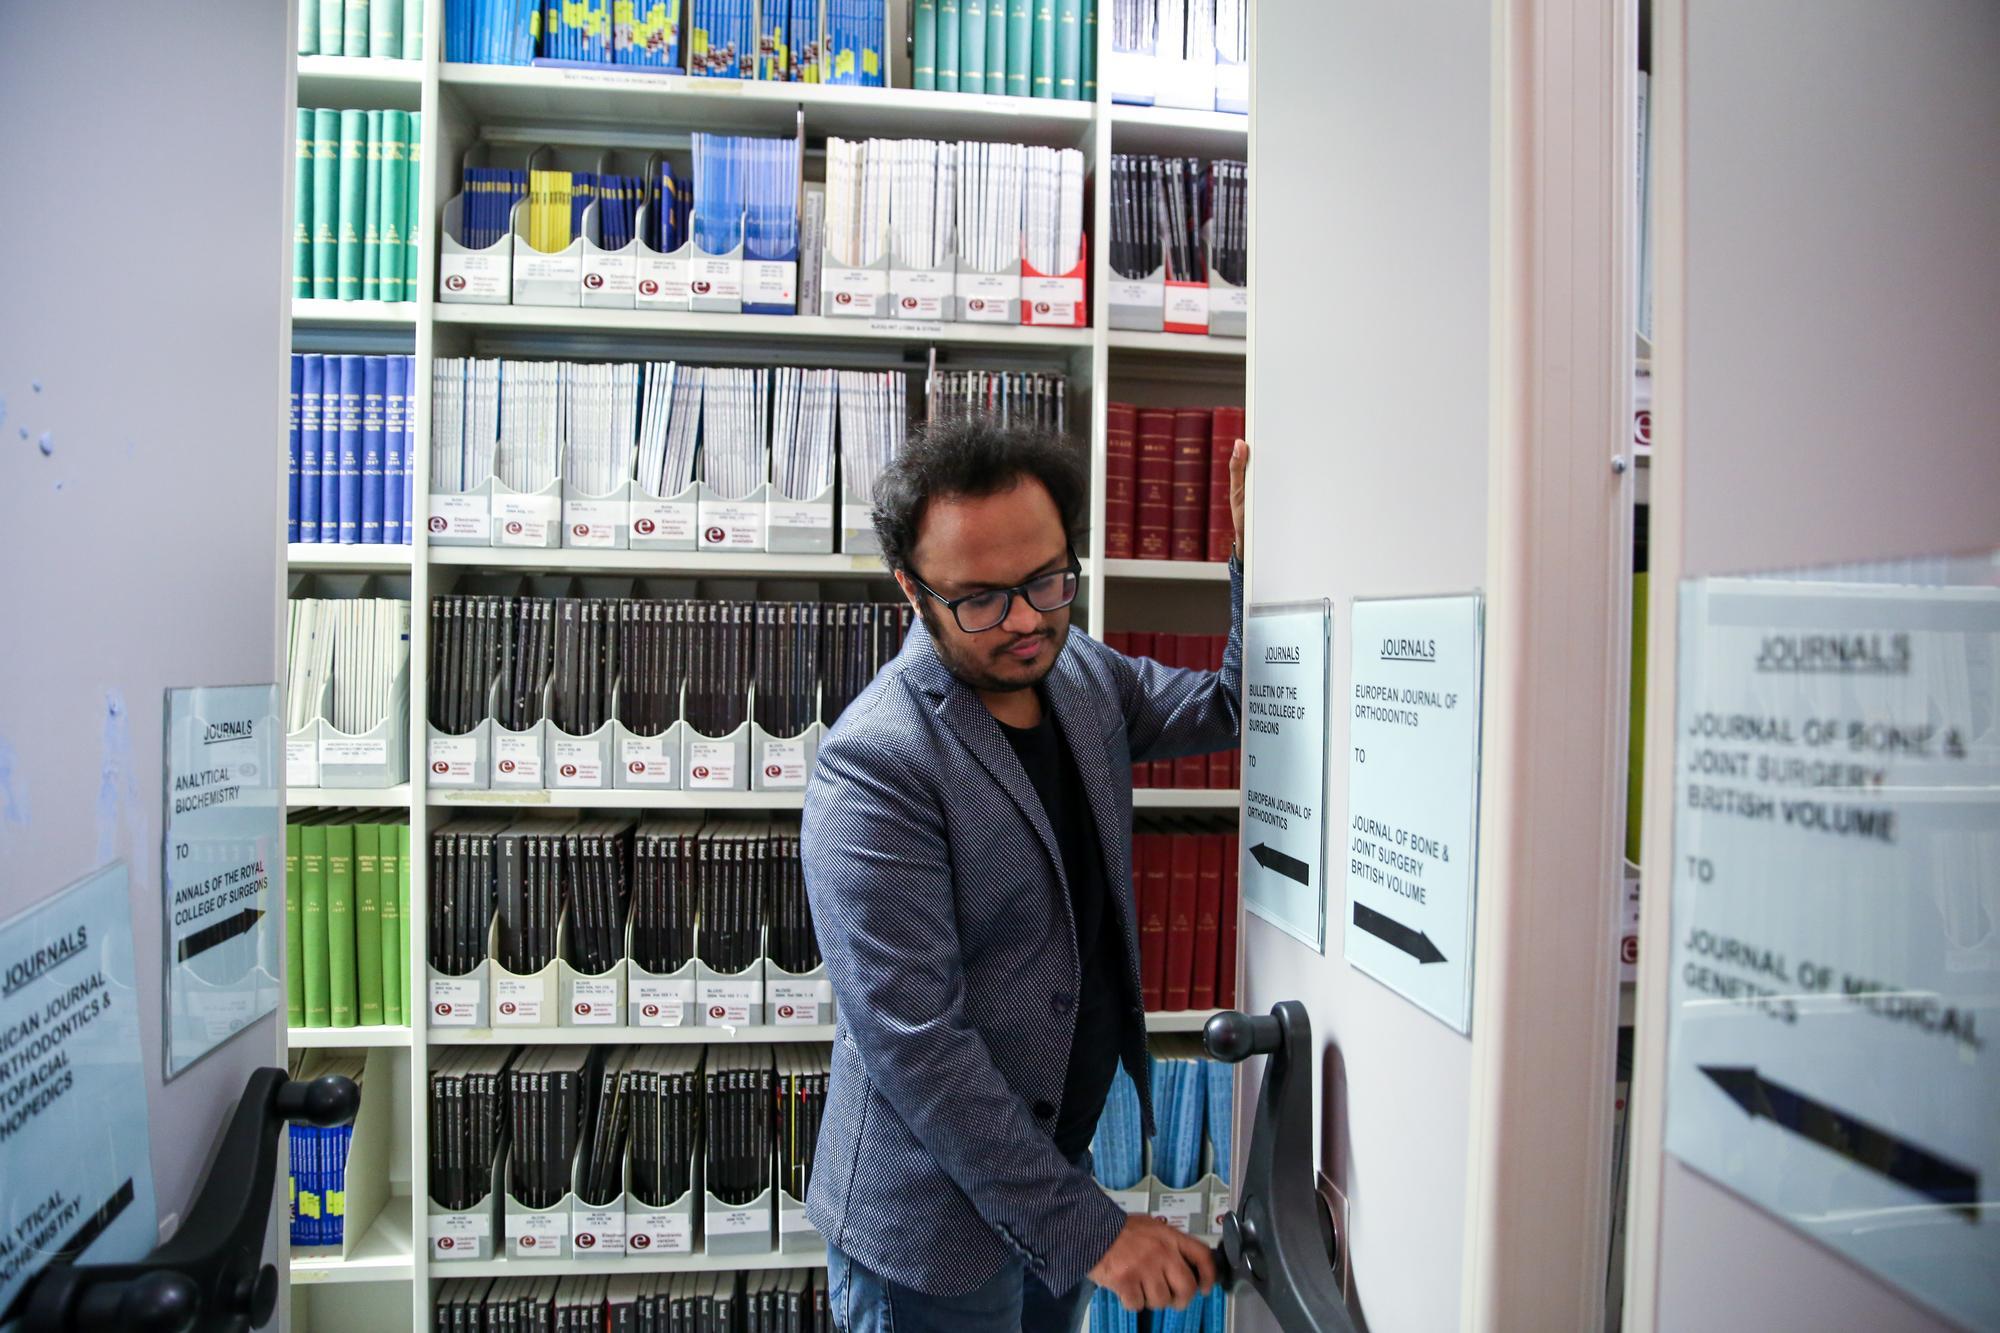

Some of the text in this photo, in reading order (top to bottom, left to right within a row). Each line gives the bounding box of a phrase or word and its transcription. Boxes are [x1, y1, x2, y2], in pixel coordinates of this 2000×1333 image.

[1265, 646, 1300, 661] JOURNALS
[1380, 639, 1436, 659] JOURNALS
[1757, 632, 1911, 669] JOURNALS
[1249, 684, 1297, 700] BULLETIN OF THE
[1355, 684, 1458, 709] EUROPEAN JOURNAL OF
[1248, 701, 1306, 720] ROYAL COLLEGE OF
[1355, 704, 1419, 727] ORTHODONTICS
[203, 719, 253, 741] JOURNALS
[1248, 719, 1280, 735] SURGEONS
[1688, 712, 1796, 745] JOURNAL
[1802, 718, 1839, 748] OF
[1248, 754, 1257, 768] TO
[1354, 747, 1366, 764] TO
[175, 768, 230, 792] ANALYTICAL
[1688, 748, 1885, 794] JOINT SURGERY
[175, 785, 240, 814] BIOCHEMISTRY
[1247, 789, 1312, 820] EUROPEAN JOURNAL OF
[1247, 806, 1288, 830] ORTHODONTICS
[1686, 784, 1898, 845] BRITISH VOLUME
[176, 843, 189, 860] TO
[1352, 815, 1450, 863] JOURNAL OF BONE &
[1352, 837, 1424, 878] JOINT SURGERY
[1685, 855, 1715, 884] TO
[174, 861, 264, 906] ANNALS OF THE ROYAL
[1351, 859, 1427, 906] BRITISH VOLUME
[175, 877, 268, 926] COLLEGE OF SURGEONS
[2, 925, 88, 993] JOURNALS
[1684, 926, 1790, 985] JOURNAL
[1796, 960, 1834, 992] OF
[0, 971, 106, 1055] ICAN JOURNAL
[103, 991, 112, 1010] &
